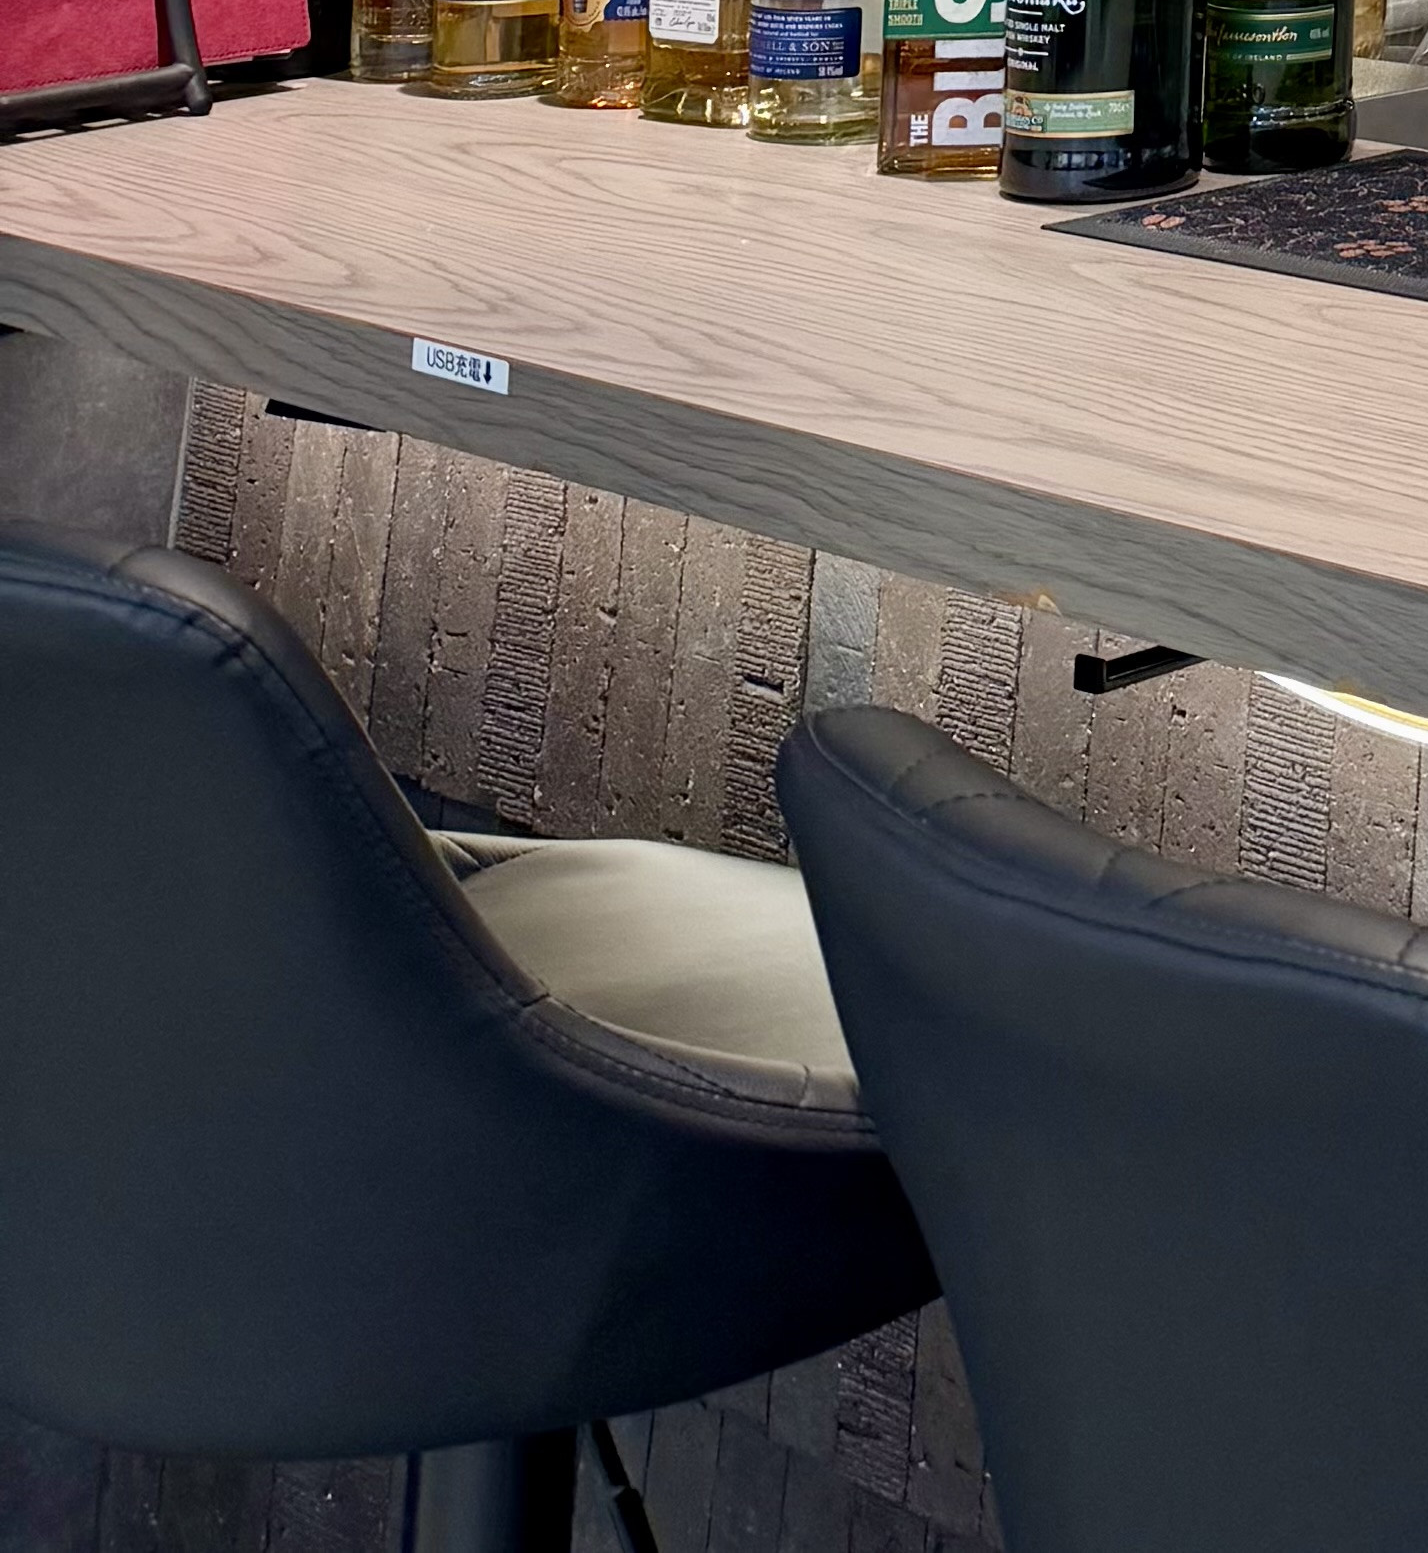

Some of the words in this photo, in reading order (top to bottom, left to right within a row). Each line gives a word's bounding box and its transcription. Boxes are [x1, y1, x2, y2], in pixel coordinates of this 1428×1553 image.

[887, 14, 923, 27] SMOOTH
[1015, 21, 1043, 33] SINGLE
[1044, 23, 1066, 34] MALT
[801, 40, 830, 52] SON
[910, 113, 929, 147] THE
[427, 345, 481, 383] USB充電
